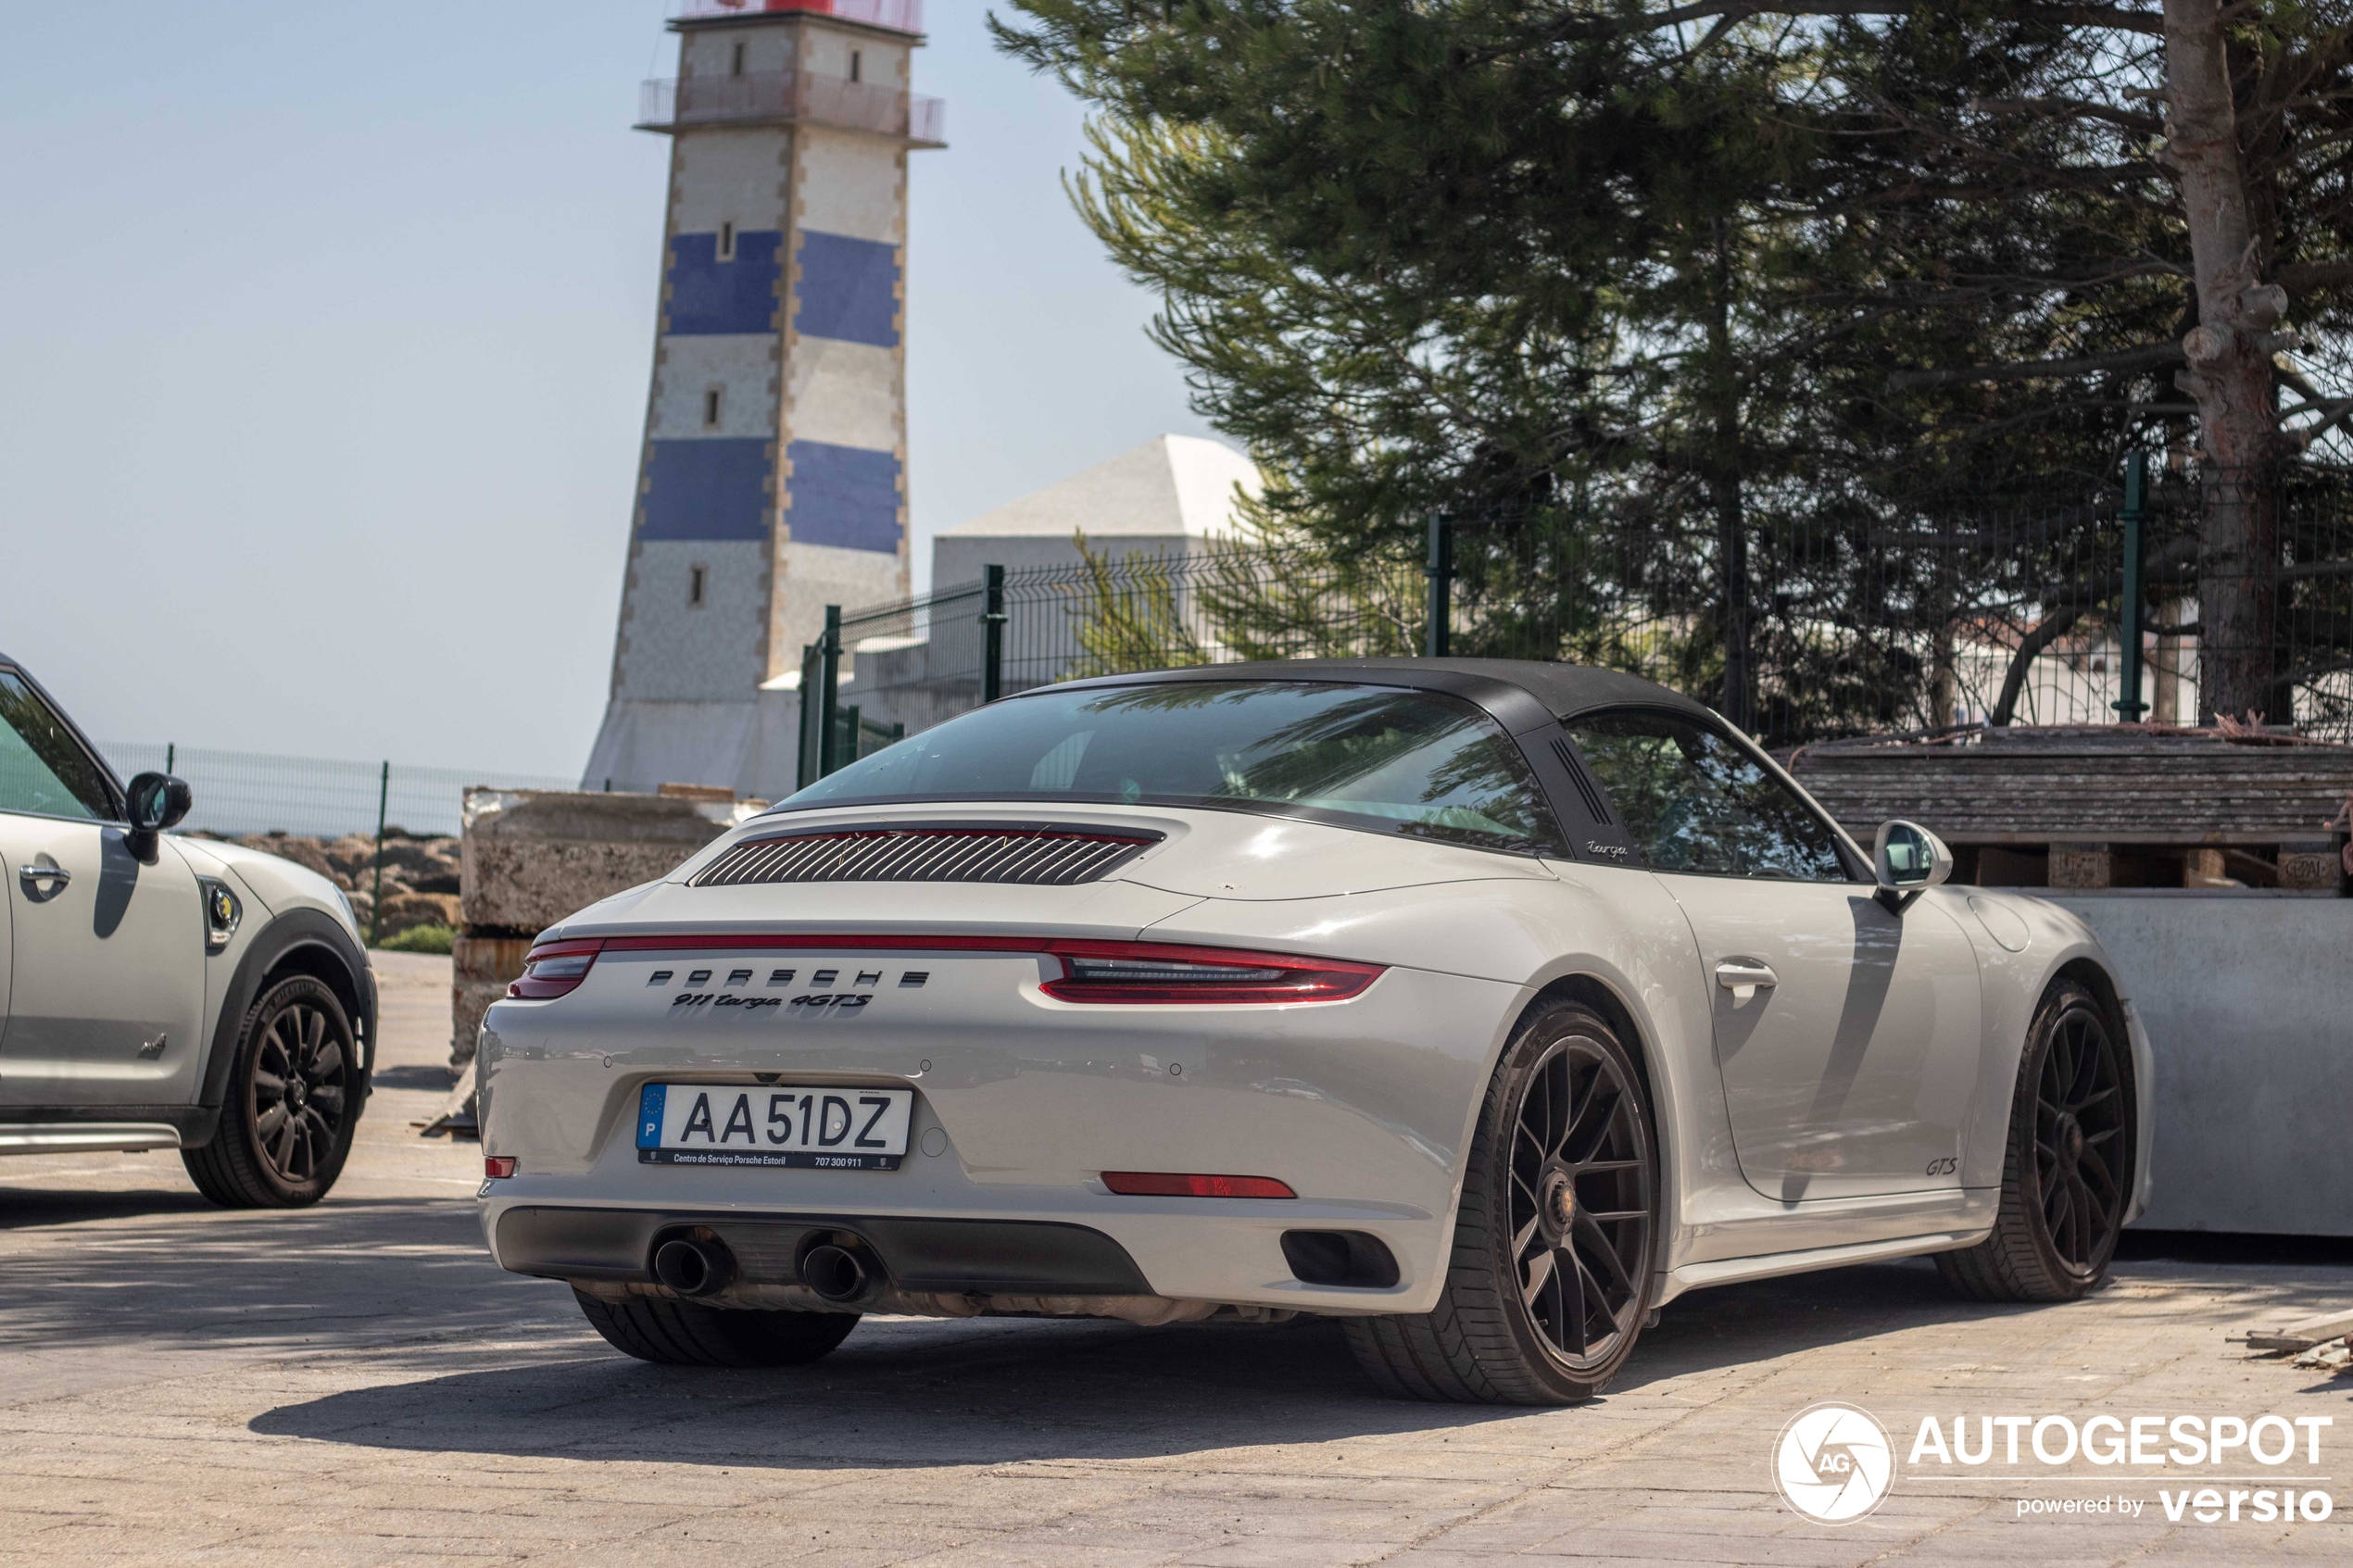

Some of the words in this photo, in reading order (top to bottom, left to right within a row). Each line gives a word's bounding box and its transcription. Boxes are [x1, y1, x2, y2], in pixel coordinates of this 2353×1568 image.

[649, 969, 930, 984] PORSCHE
[673, 994, 715, 1007] 911
[714, 994, 783, 1010] targa
[646, 1123, 656, 1136] P
[673, 1153, 697, 1163] Centro
[698, 1154, 707, 1163] de
[707, 1154, 733, 1165] Serviço
[734, 1155, 762, 1165] Porsche
[763, 1156, 786, 1165] Estoril
[815, 1157, 830, 1167] 707
[831, 1158, 846, 1167] 300
[847, 1158, 862, 1167] 911
[1926, 1158, 1958, 1176] GTS
